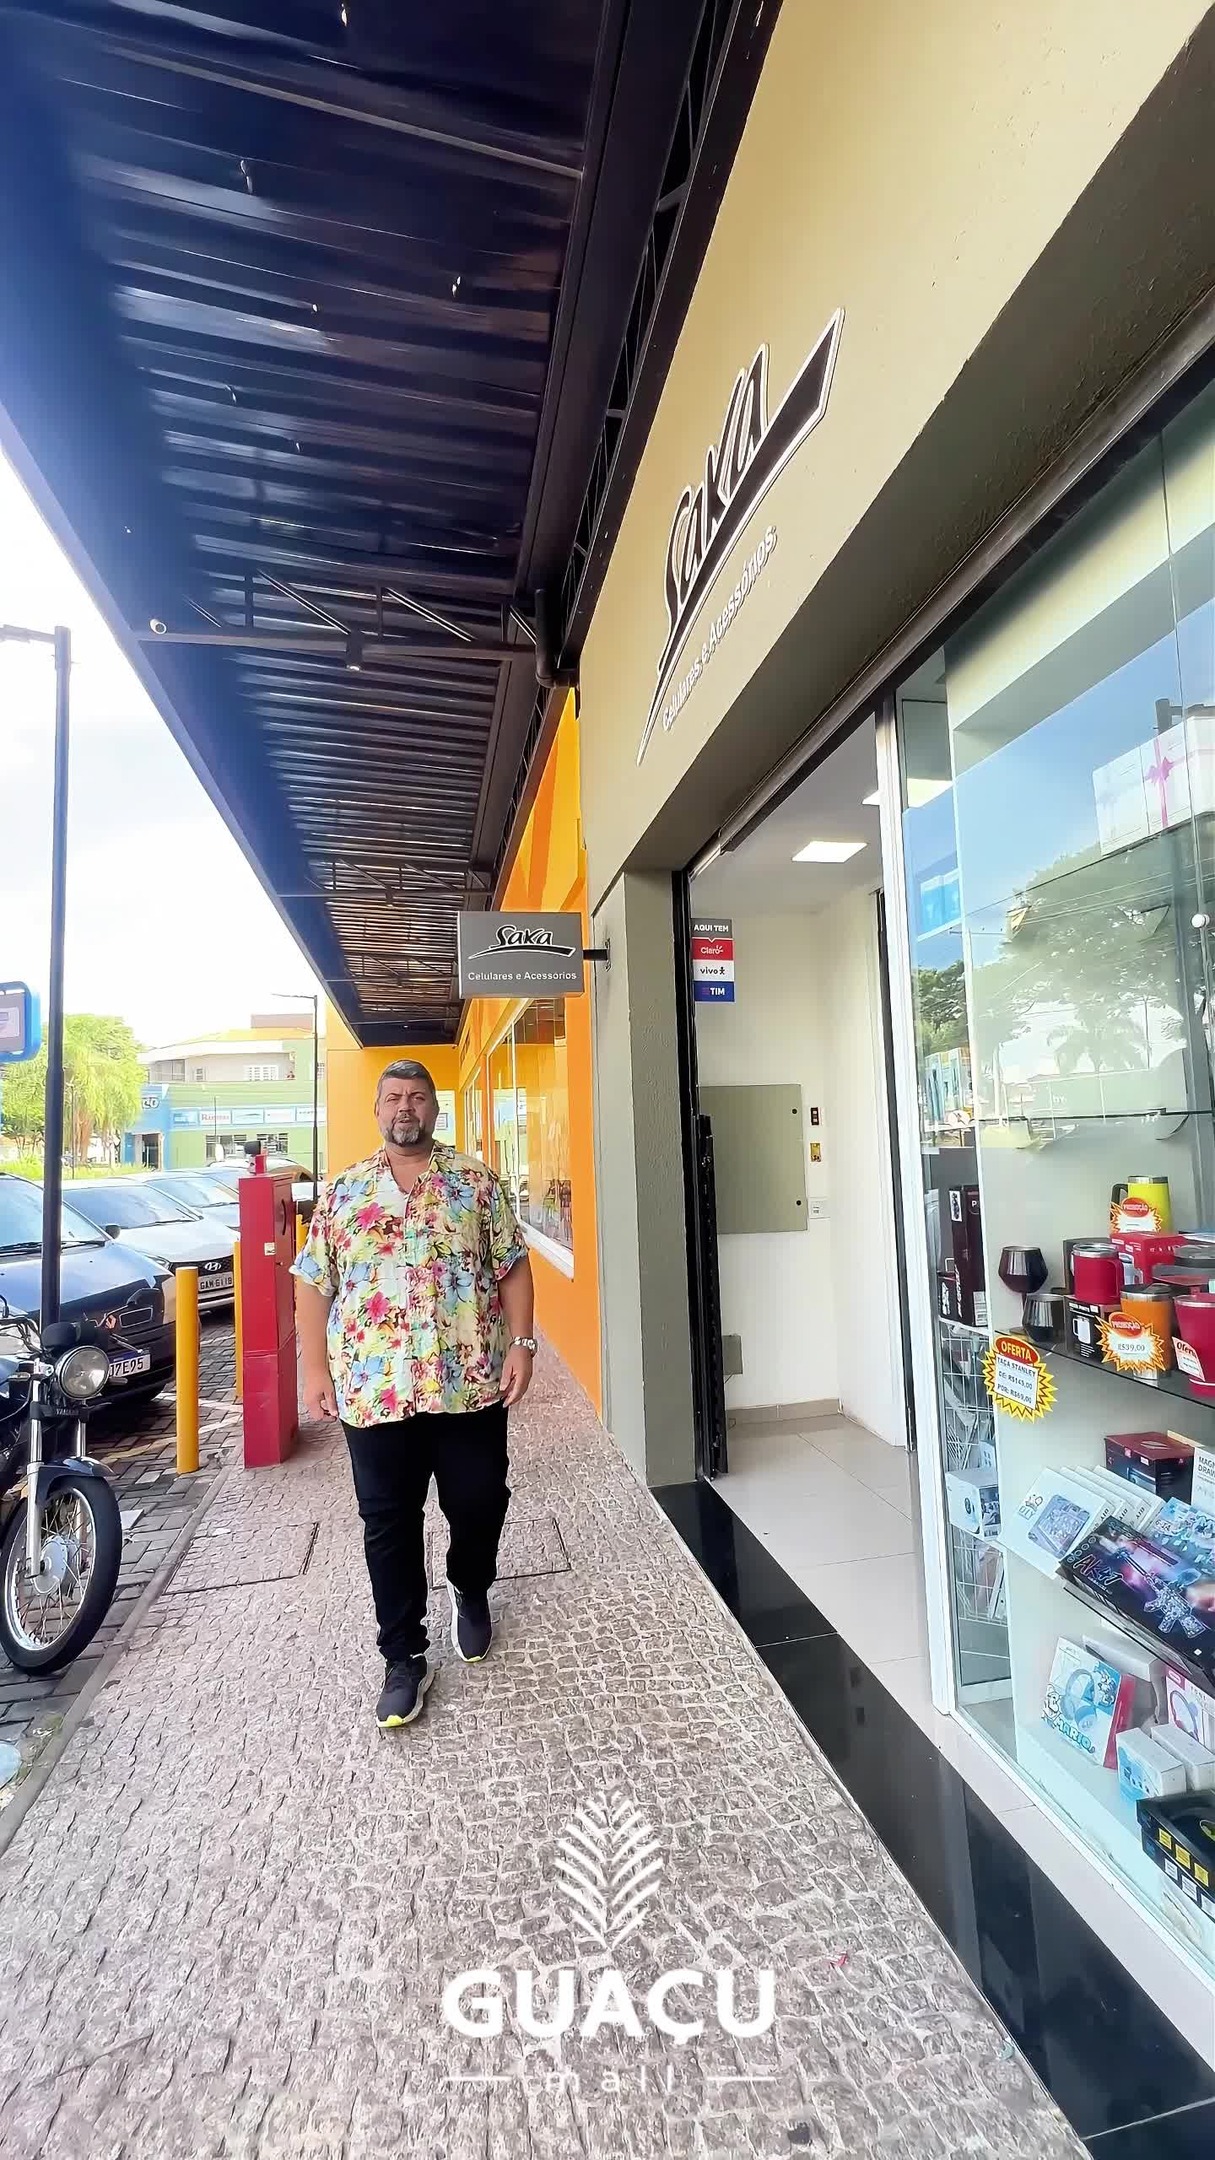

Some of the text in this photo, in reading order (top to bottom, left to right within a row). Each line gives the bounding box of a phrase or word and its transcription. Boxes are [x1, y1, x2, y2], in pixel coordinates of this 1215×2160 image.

[662, 662, 704, 732] Celulares
[709, 525, 778, 649] Acessórios
[693, 924, 713, 932] AQUI
[700, 946, 721, 955] Claro
[700, 966, 719, 975] vivo
[467, 972, 513, 981] Celulares
[523, 971, 577, 981] Acessórios
[709, 987, 726, 996] TIM
[1000, 1340, 1032, 1361] OFERTA
[1011, 1362, 1036, 1377] STANLEY
